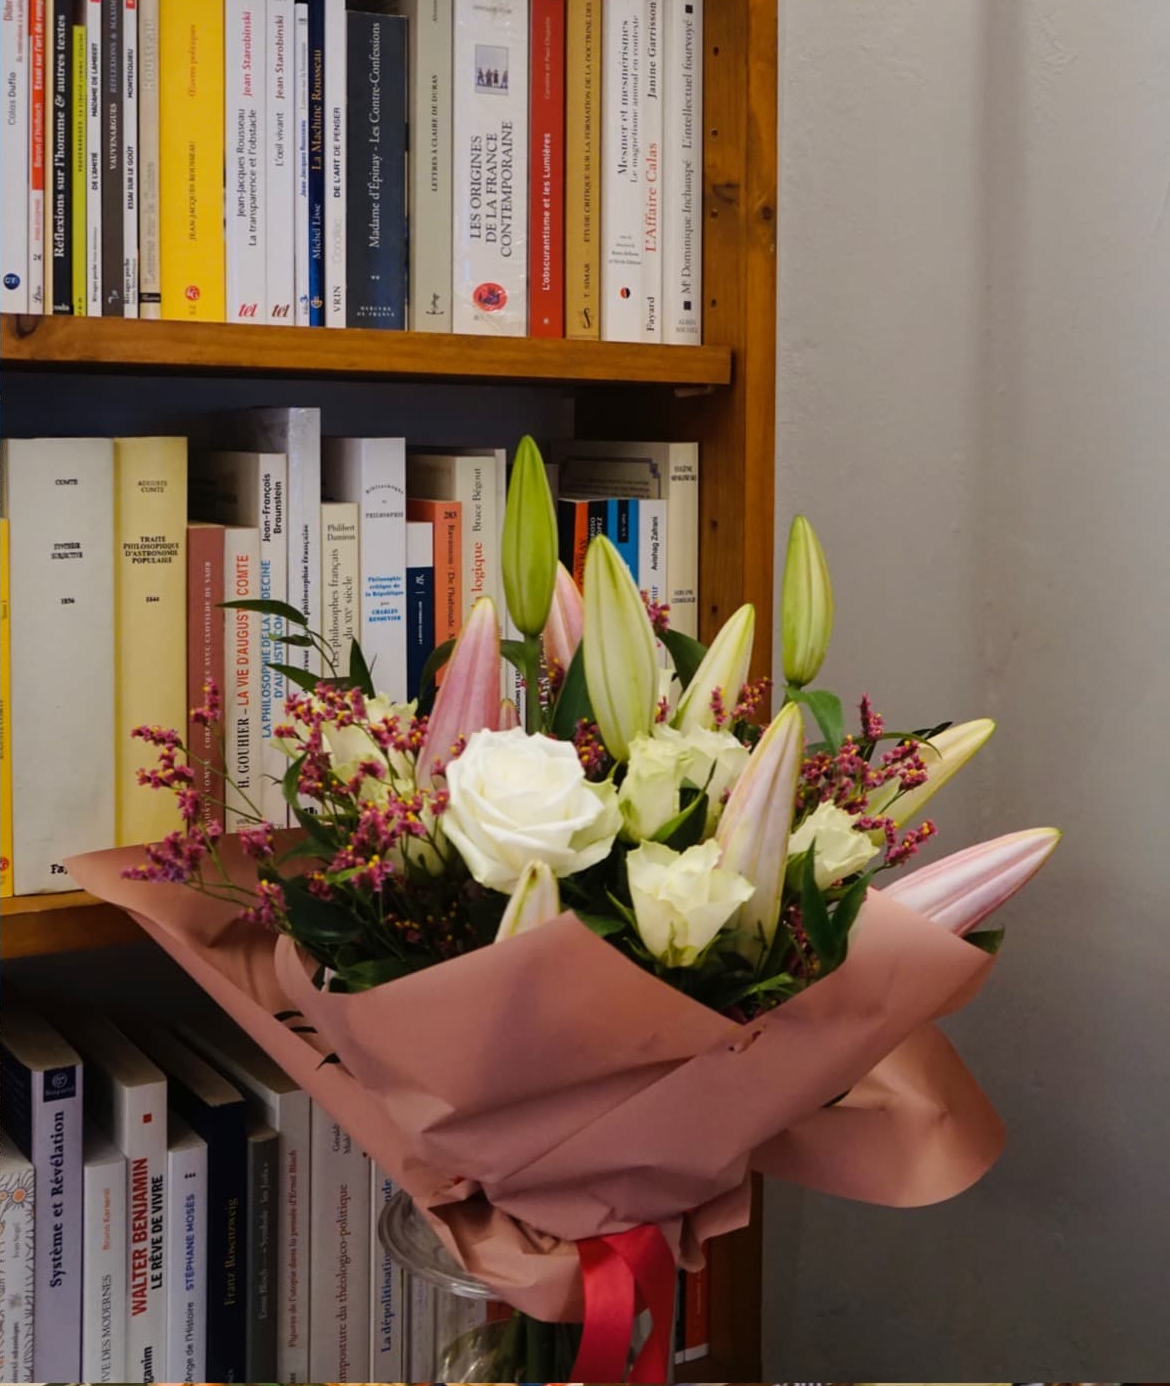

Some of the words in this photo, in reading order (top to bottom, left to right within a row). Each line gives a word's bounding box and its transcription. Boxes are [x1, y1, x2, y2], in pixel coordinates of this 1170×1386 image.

[54, 15, 66, 50] textes
[241, 11, 251, 70] Starobinski
[275, 15, 284, 74] Starobinski
[647, 1, 657, 58] Garrisson
[680, 20, 696, 70] fourvoyé
[54, 54, 65, 93] autres
[241, 73, 252, 97] Jean
[312, 49, 321, 101] Rousseau
[369, 22, 380, 123] Contre-Confessions
[616, 20, 629, 106] mesmérismes
[646, 61, 659, 100] Janine
[275, 76, 285, 99] Jean
[236, 109, 246, 153] Rousseau
[247, 109, 257, 155] l'obstacle
[276, 112, 284, 141] vivant
[312, 106, 321, 152] Machine
[680, 73, 694, 149] L'intellectuel
[53, 111, 65, 167] l'homme
[109, 103, 117, 170] VAUVENARGUES
[369, 127, 380, 143] Les
[541, 133, 551, 178] Lumières
[617, 124, 629, 174] Mesmer
[55, 169, 65, 190] sur
[312, 156, 321, 170] La
[368, 154, 382, 200] d'Épinay
[470, 135, 481, 209] ORIGINES
[485, 133, 498, 194] FRANCE
[645, 142, 658, 182] Calas
[236, 156, 247, 217] Jean-Jacques
[249, 166, 259, 234] transparence
[333, 185, 340, 198] DE
[485, 199, 498, 218] LA
[500, 121, 513, 257] CONTEMPORAINE
[542, 181, 551, 195] les
[680, 159, 695, 213] Inchauspé
[53, 194, 65, 257] Réflexions
[248, 235, 257, 246] La
[369, 202, 380, 247] Madame
[470, 213, 481, 239] LES
[485, 222, 498, 243] DE
[645, 186, 658, 252] L'Affaire
[542, 210, 551, 291] L'obscurantisme
[680, 213, 695, 277] Dominique
[333, 286, 341, 313] VRIN
[646, 296, 657, 332] Fayard
[261, 473, 272, 542] Jean-François
[273, 481, 282, 534] Braunstein
[472, 504, 482, 532] Bruce
[650, 516, 658, 542] Zafrani
[236, 555, 249, 596] COMTE
[328, 548, 342, 587] français
[471, 542, 485, 592] logique
[343, 576, 353, 604] siècle
[328, 589, 342, 648] philosophes
[343, 626, 353, 640] du
[236, 669, 249, 688] VIE
[236, 690, 249, 706] LA
[237, 718, 250, 773] GOUHIER
[49, 1111, 65, 1196] Révélation
[50, 1201, 63, 1217] et
[131, 1158, 148, 1243] BENJAMIN
[151, 1174, 163, 1215] VIVRE
[183, 1194, 195, 1232] MOSÈS
[151, 1217, 163, 1233] DE
[335, 1183, 352, 1302] théologico-politique
[49, 1223, 66, 1288] Système
[149, 1238, 163, 1270] RÊVE
[184, 1233, 195, 1291] STÉPHANE
[132, 1249, 148, 1316] WALTER
[150, 1273, 163, 1290] LE
[101, 1273, 111, 1337] MODERNES
[185, 1302, 195, 1342] l'Histoire
[336, 1305, 348, 1321] du
[380, 1335, 392, 1353] La
